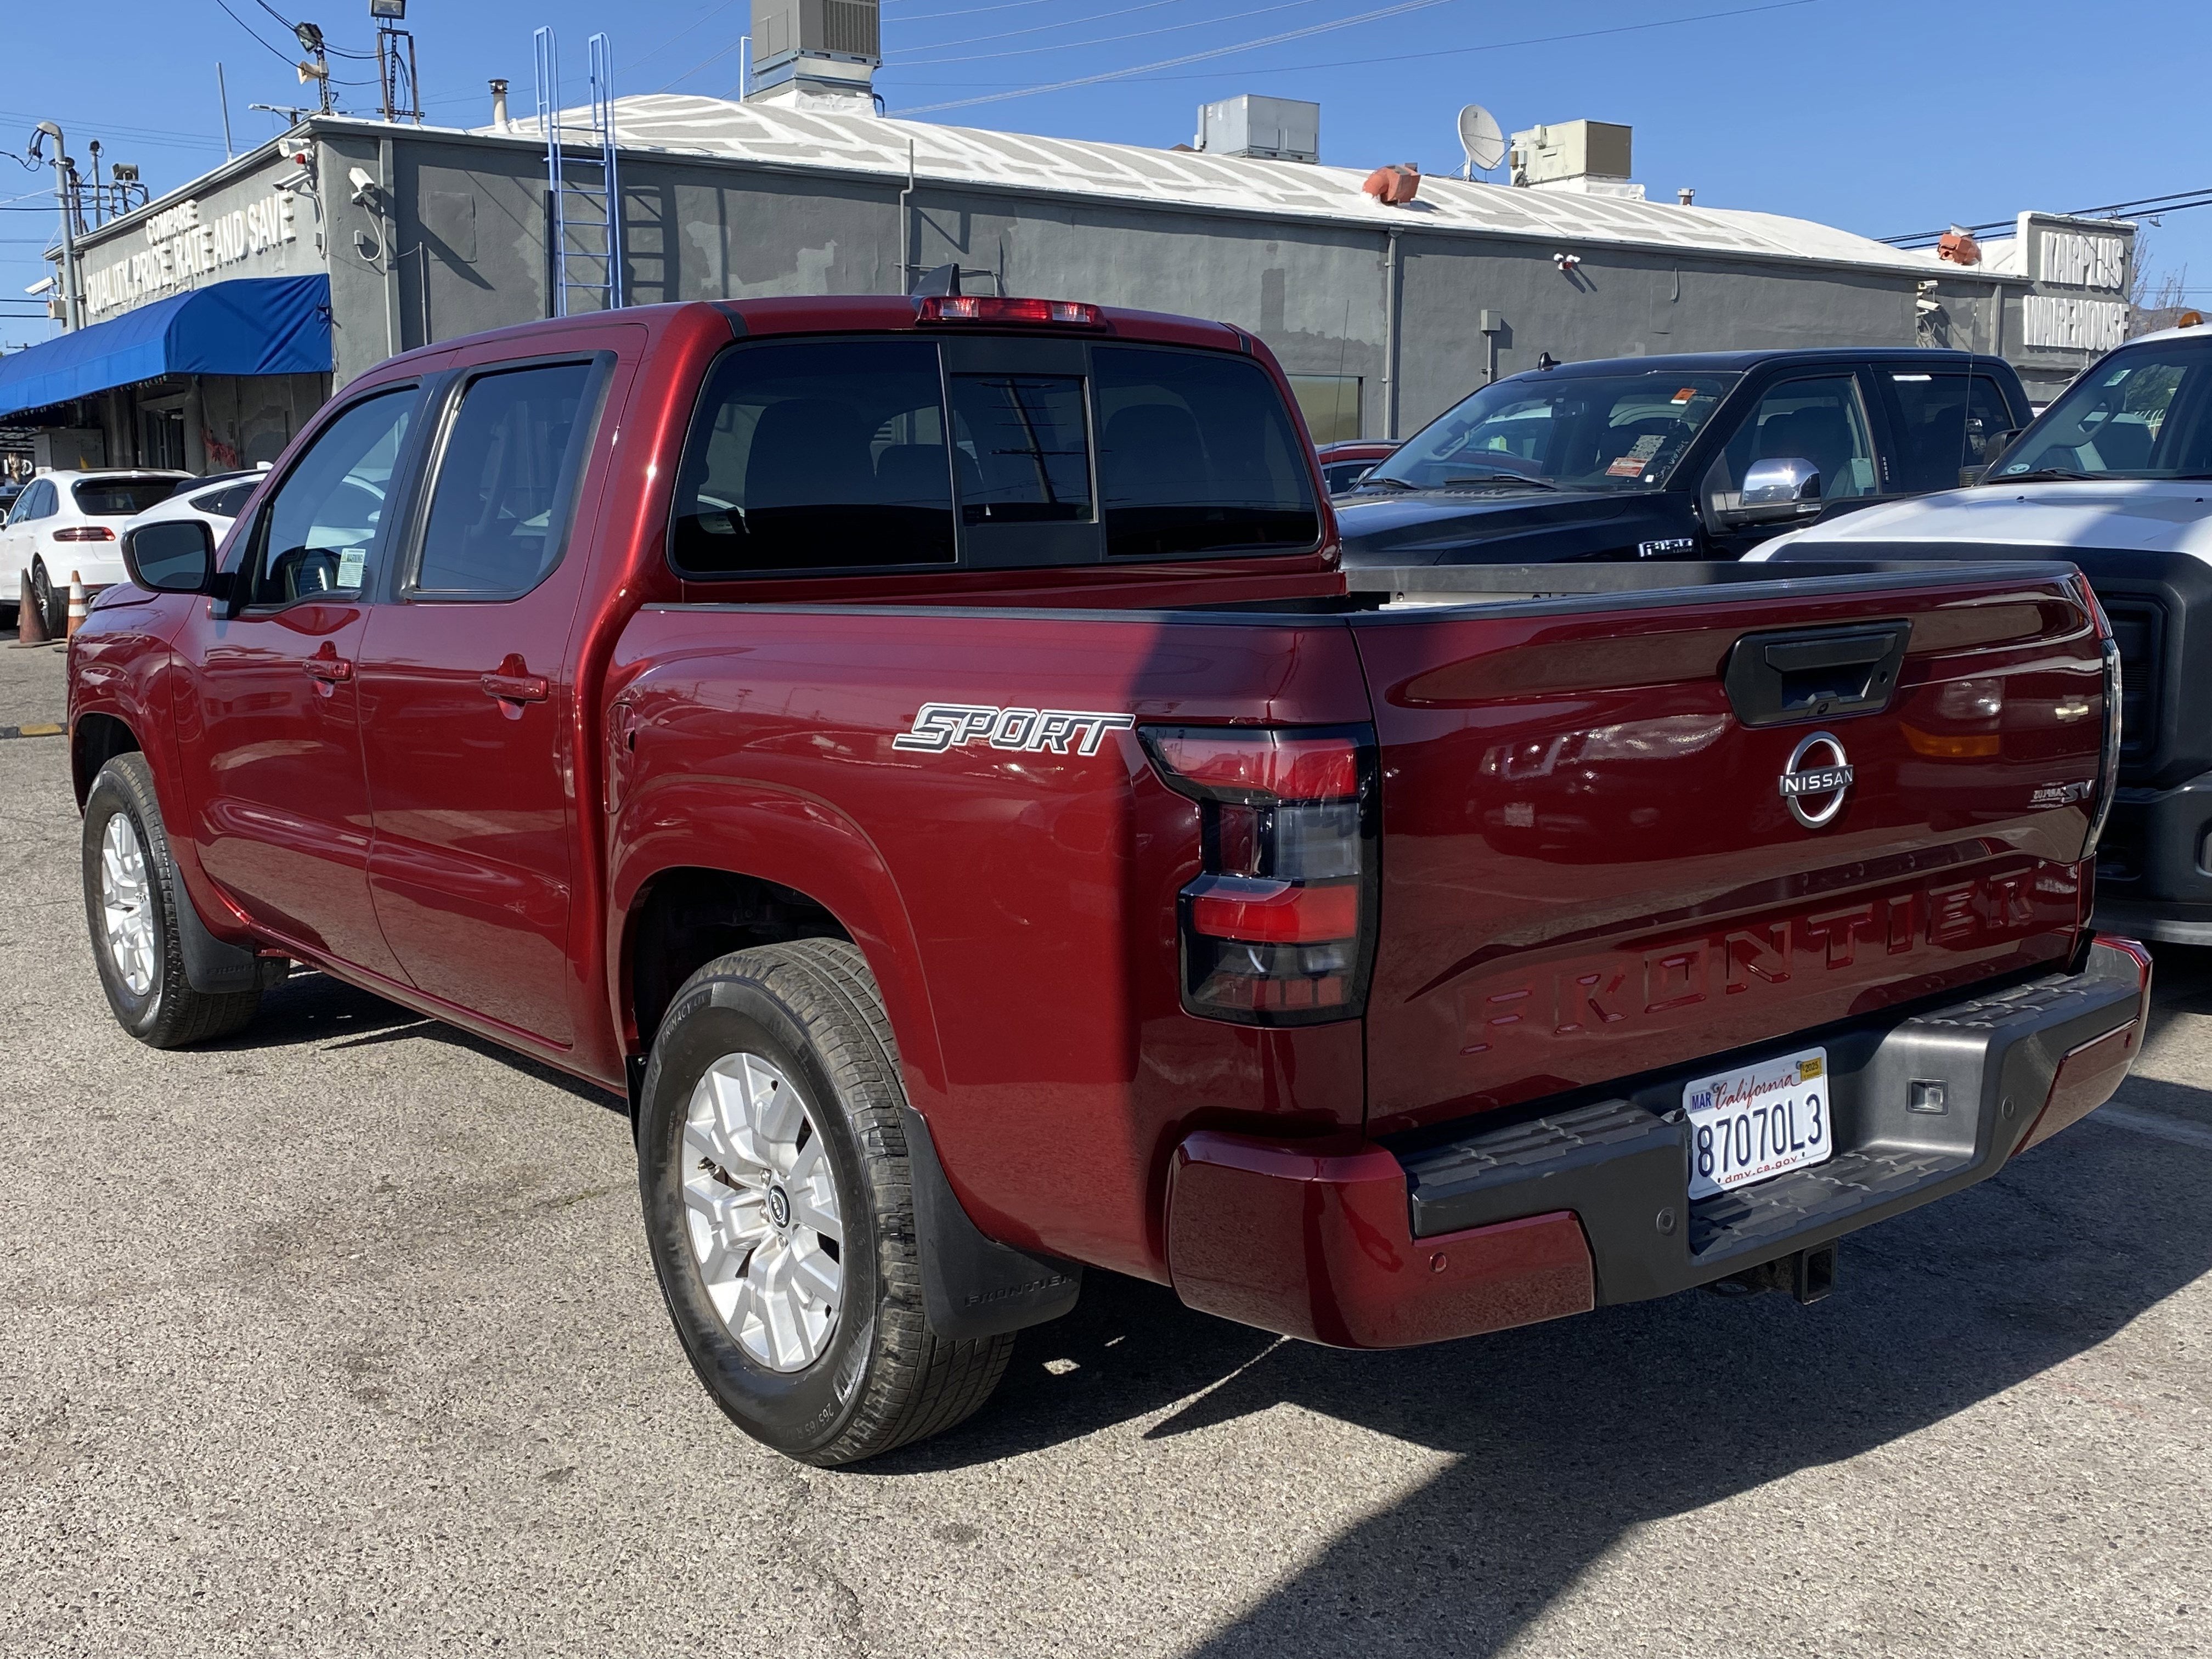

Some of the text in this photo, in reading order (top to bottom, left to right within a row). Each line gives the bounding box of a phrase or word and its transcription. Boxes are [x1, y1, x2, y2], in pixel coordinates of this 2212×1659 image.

[146, 199, 199, 244] COMPARE
[173, 224, 213, 280] RATE
[213, 210, 247, 265] AND
[247, 189, 296, 252] SAVE
[2040, 231, 2124, 288] KARPLUS
[2023, 295, 2130, 352] WAREHOUSE
[892, 702, 1135, 756] SPORT
[1785, 769, 1853, 792] NISSAN
[2061, 779, 2096, 803] SV
[1459, 866, 2034, 1056] FRONTIER
[662, 1002, 692, 1045] PRIMACY
[1692, 1074, 1802, 1110] MAR California
[1697, 1093, 1822, 1177] 87070L3
[1725, 1155, 1798, 1183] dmv.ca.gov
